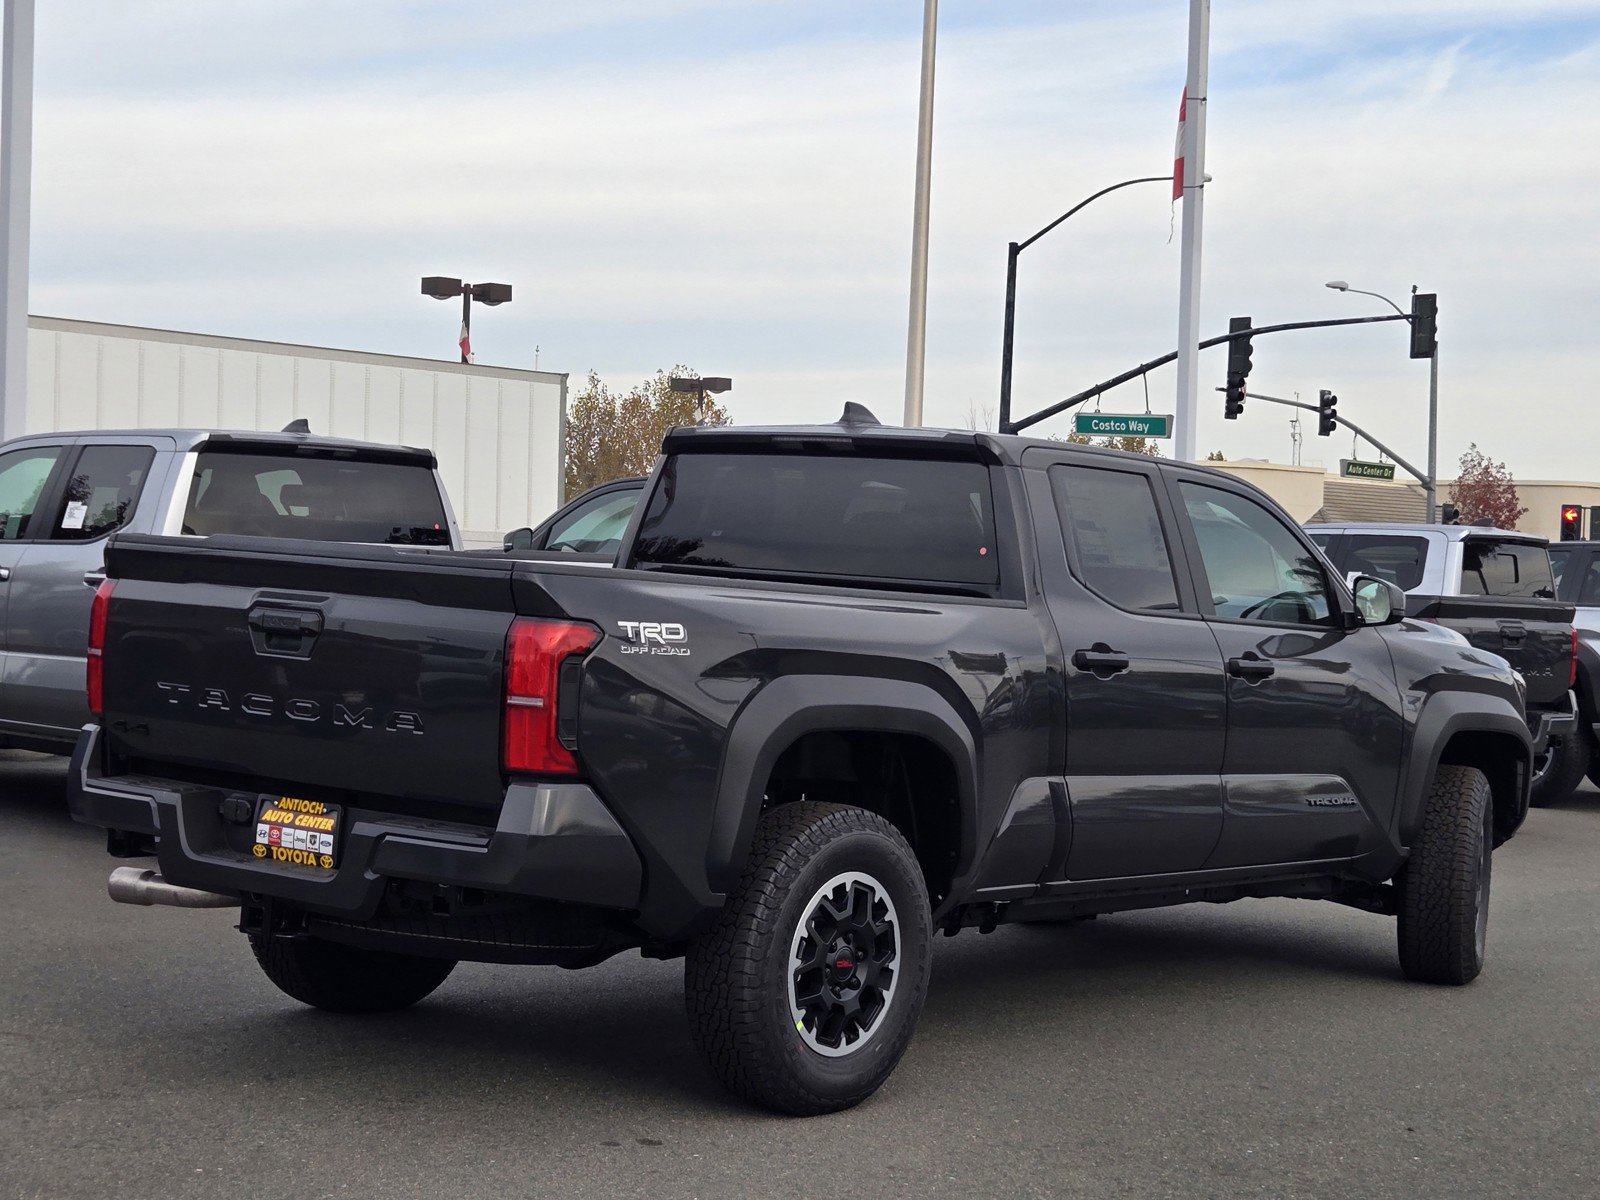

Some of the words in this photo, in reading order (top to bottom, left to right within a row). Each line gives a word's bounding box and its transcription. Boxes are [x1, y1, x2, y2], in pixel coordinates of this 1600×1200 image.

[1091, 419, 1126, 431] Costco
[1128, 420, 1149, 433] Way
[1348, 464, 1362, 474] Auto
[1363, 466, 1383, 476] Center
[1383, 468, 1392, 477] Dr
[617, 621, 685, 644] TRD
[620, 645, 648, 655] OFF
[650, 646, 691, 656] ROAD
[156, 681, 424, 735] TACOMA
[278, 796, 324, 815] ANTIOCH
[1304, 797, 1358, 807] TACOMA
[261, 809, 294, 824] AUTO
[294, 814, 335, 831] CENTER
[271, 846, 317, 866] TOYOTA
